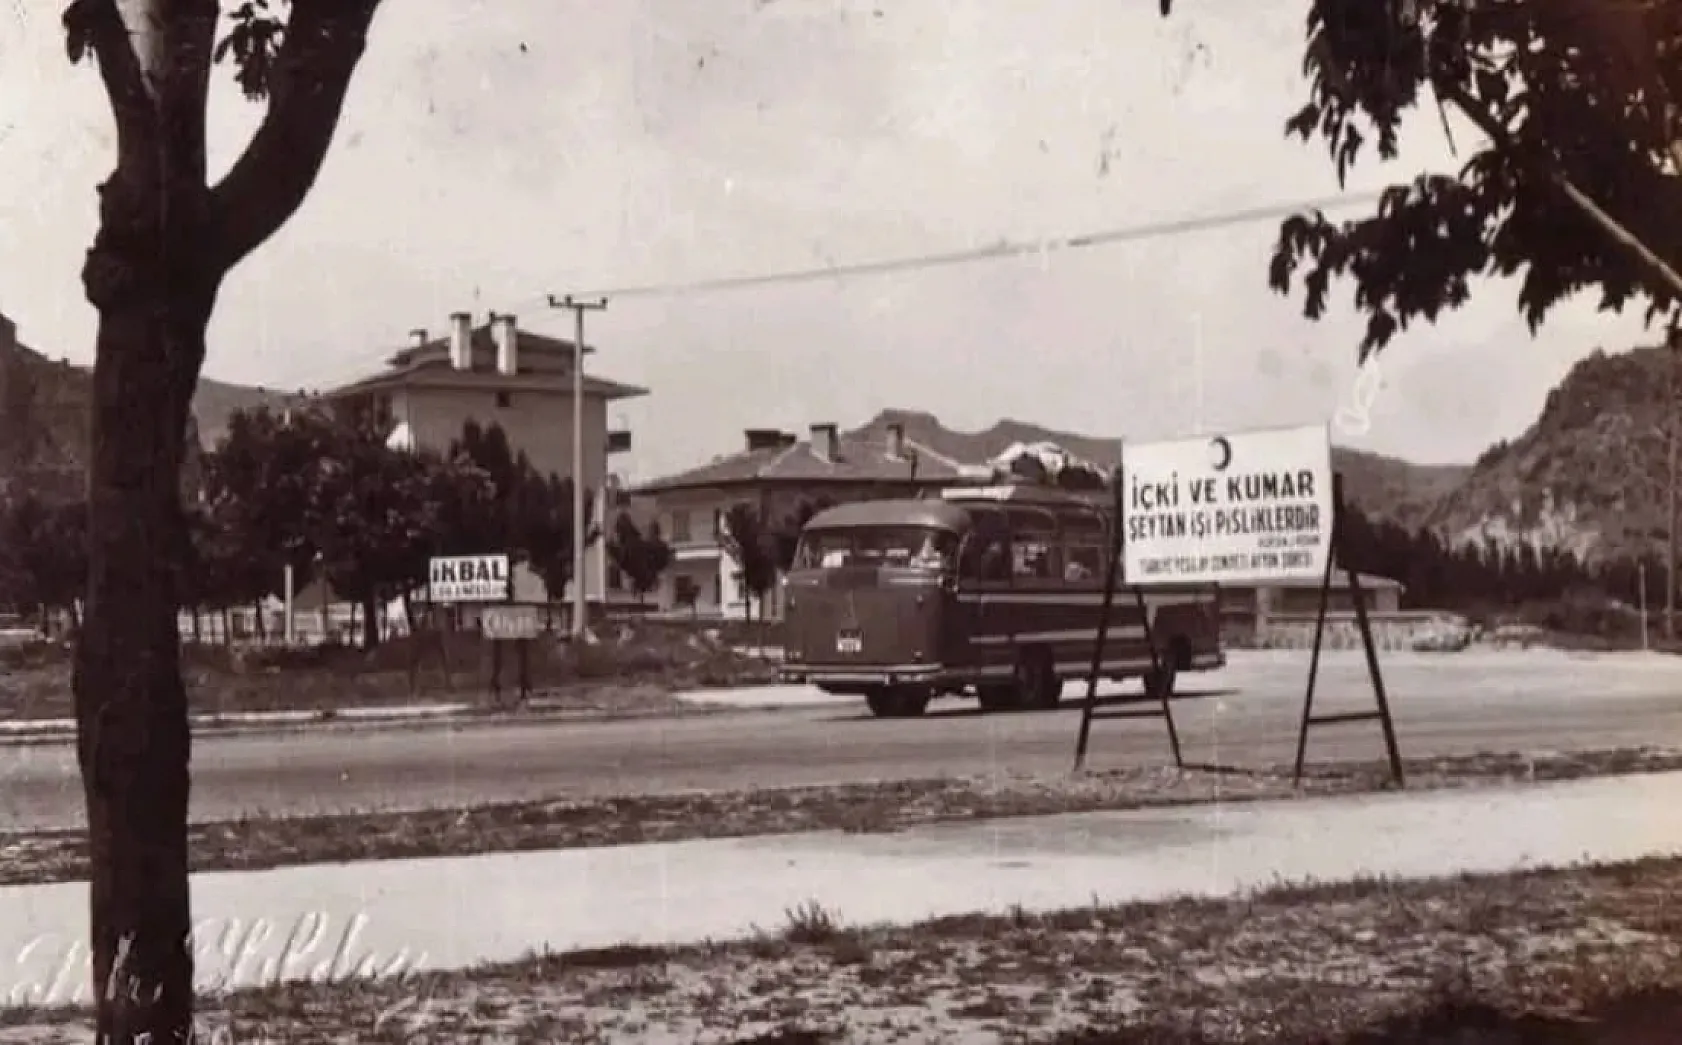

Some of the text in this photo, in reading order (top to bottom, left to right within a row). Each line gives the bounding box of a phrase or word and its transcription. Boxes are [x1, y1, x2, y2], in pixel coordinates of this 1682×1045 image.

[1131, 469, 1315, 512] İÇKİ VE KUMAR
[1128, 512, 1185, 542] ŞEYTAN
